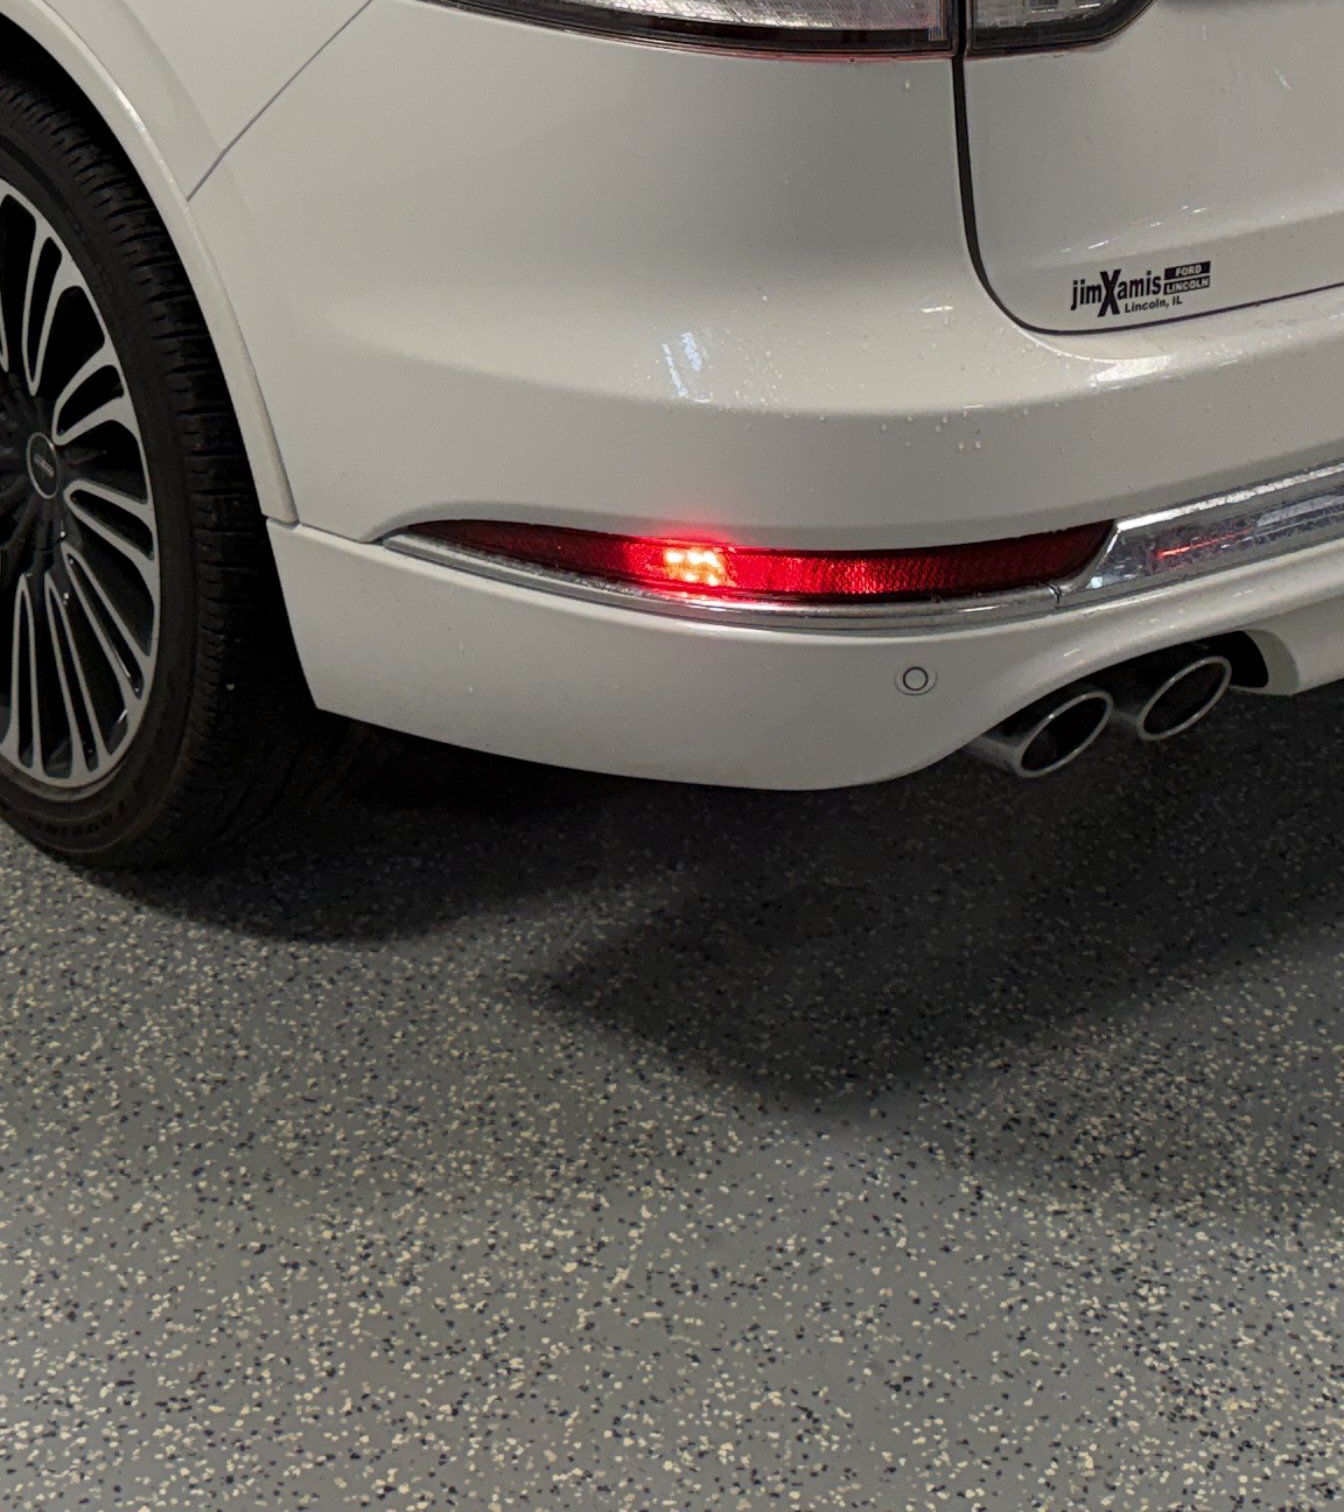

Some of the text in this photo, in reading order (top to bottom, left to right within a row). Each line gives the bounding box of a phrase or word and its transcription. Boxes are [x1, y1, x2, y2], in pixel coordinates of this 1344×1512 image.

[1175, 264, 1202, 277] FORD
[1167, 279, 1210, 294] LINCOLN
[1124, 296, 1183, 314] Lincoln, IL
